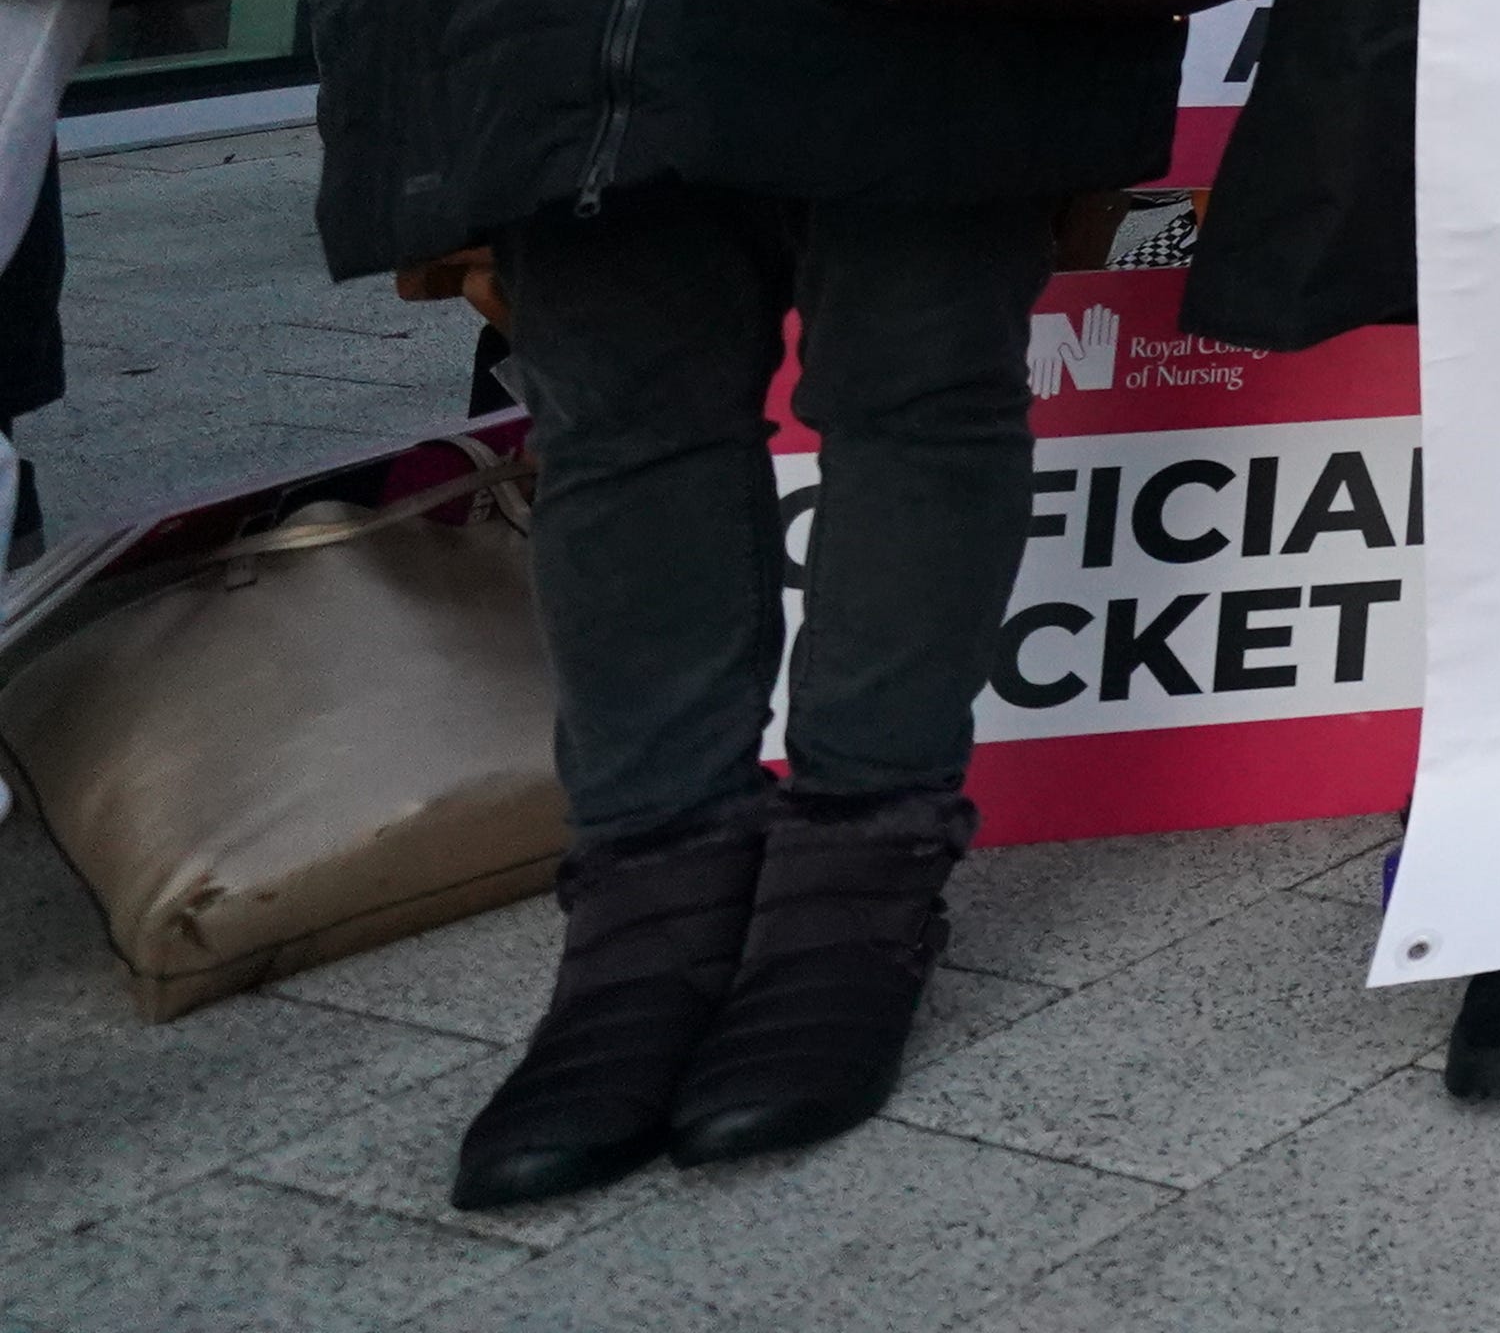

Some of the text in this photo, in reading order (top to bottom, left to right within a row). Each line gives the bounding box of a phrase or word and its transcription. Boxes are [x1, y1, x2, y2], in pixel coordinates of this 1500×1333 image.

[1129, 334, 1192, 364] Royal
[1125, 363, 1244, 390] of Nursing
[988, 579, 1402, 709] CKET
